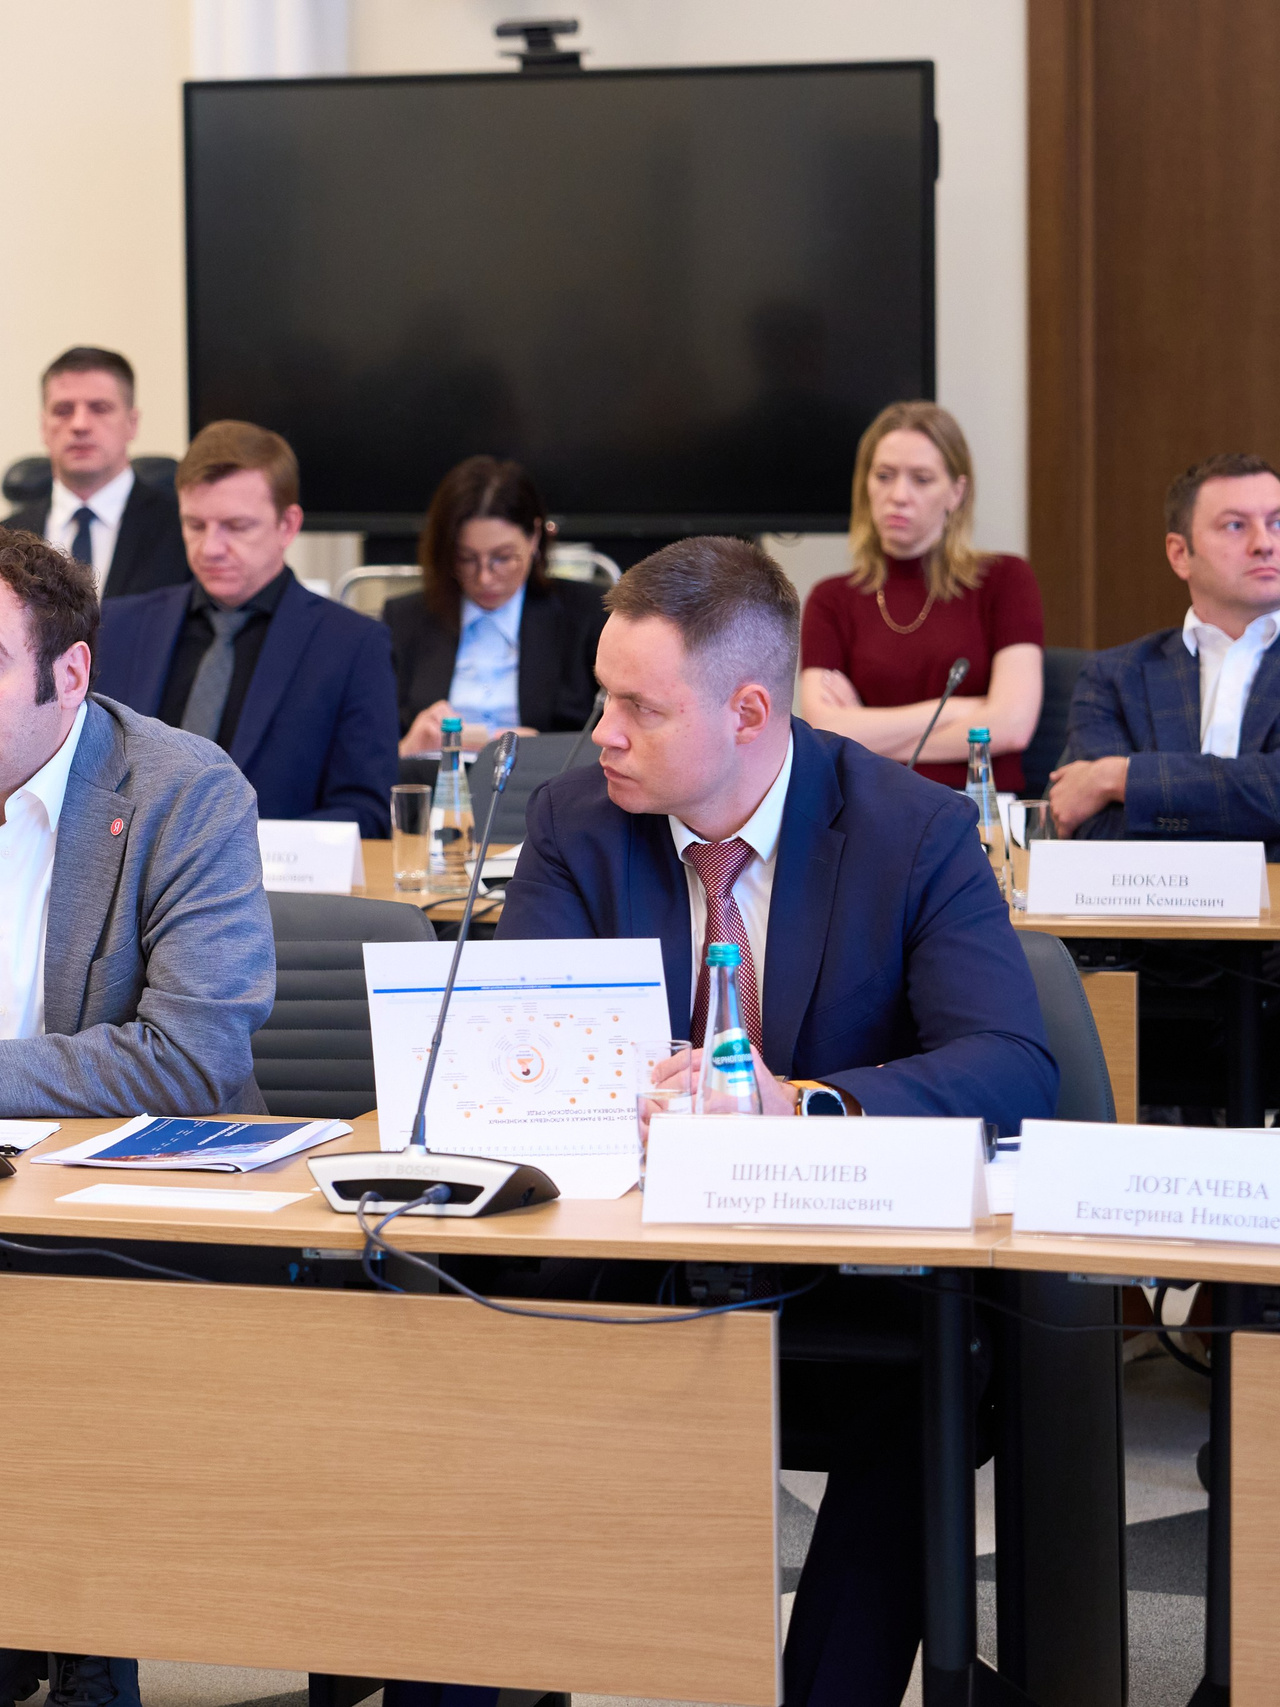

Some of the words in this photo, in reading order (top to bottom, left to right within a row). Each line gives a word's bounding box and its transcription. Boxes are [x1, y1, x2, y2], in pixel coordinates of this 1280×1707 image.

[1111, 873, 1189, 888] ЕНОКАЕВ
[1074, 893, 1142, 907] Валентин
[1146, 893, 1225, 909] Кемилевич
[395, 1164, 441, 1177] BOSCH
[731, 1163, 868, 1183] ШИНАЛИЕВ
[1124, 1173, 1270, 1200] ЛОЗГАЧЕВА
[703, 1190, 766, 1214] Тимур
[772, 1191, 895, 1212] Николаевич
[1075, 1200, 1184, 1227] Екатерина
